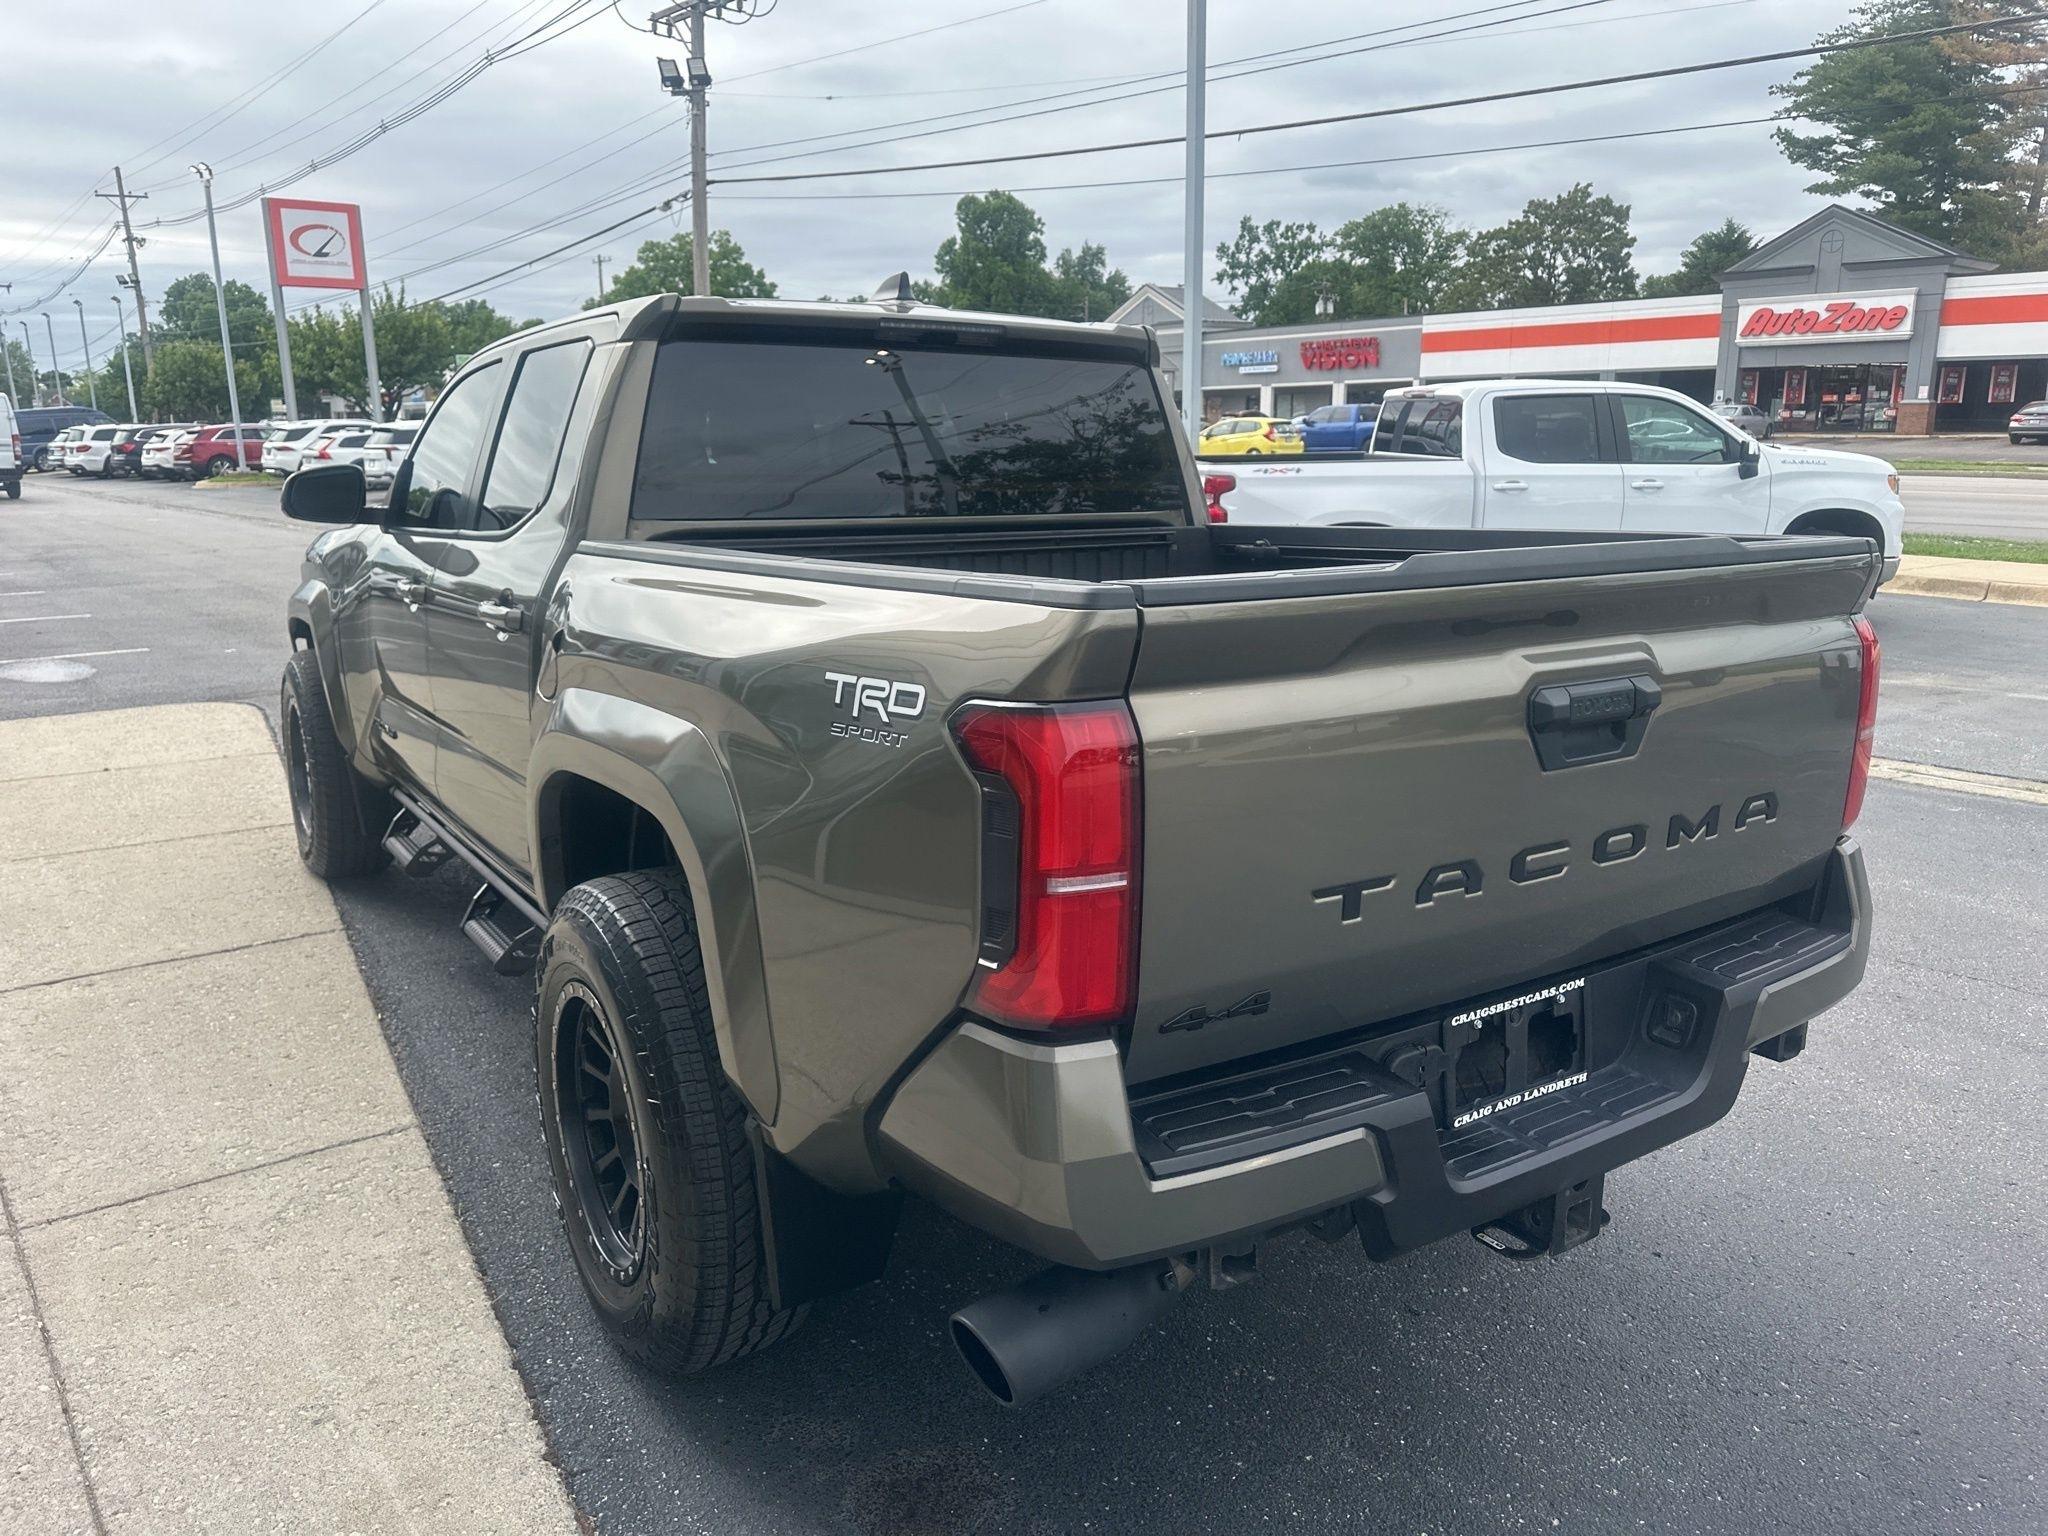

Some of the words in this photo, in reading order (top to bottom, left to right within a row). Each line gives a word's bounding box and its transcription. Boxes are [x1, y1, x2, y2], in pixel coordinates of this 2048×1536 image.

[1740, 302, 1908, 338] AutoZone
[1300, 348, 1380, 370] VISION
[825, 671, 926, 723] TRD
[830, 723, 909, 748] SPORT
[1311, 790, 1779, 925] TACOMA
[1451, 977, 1586, 1027] CRAIGSBESTCARS.COM
[1454, 1105, 1493, 1128] CRAIG
[1495, 1094, 1522, 1112] AND
[1524, 1072, 1588, 1103] LANDRETH
